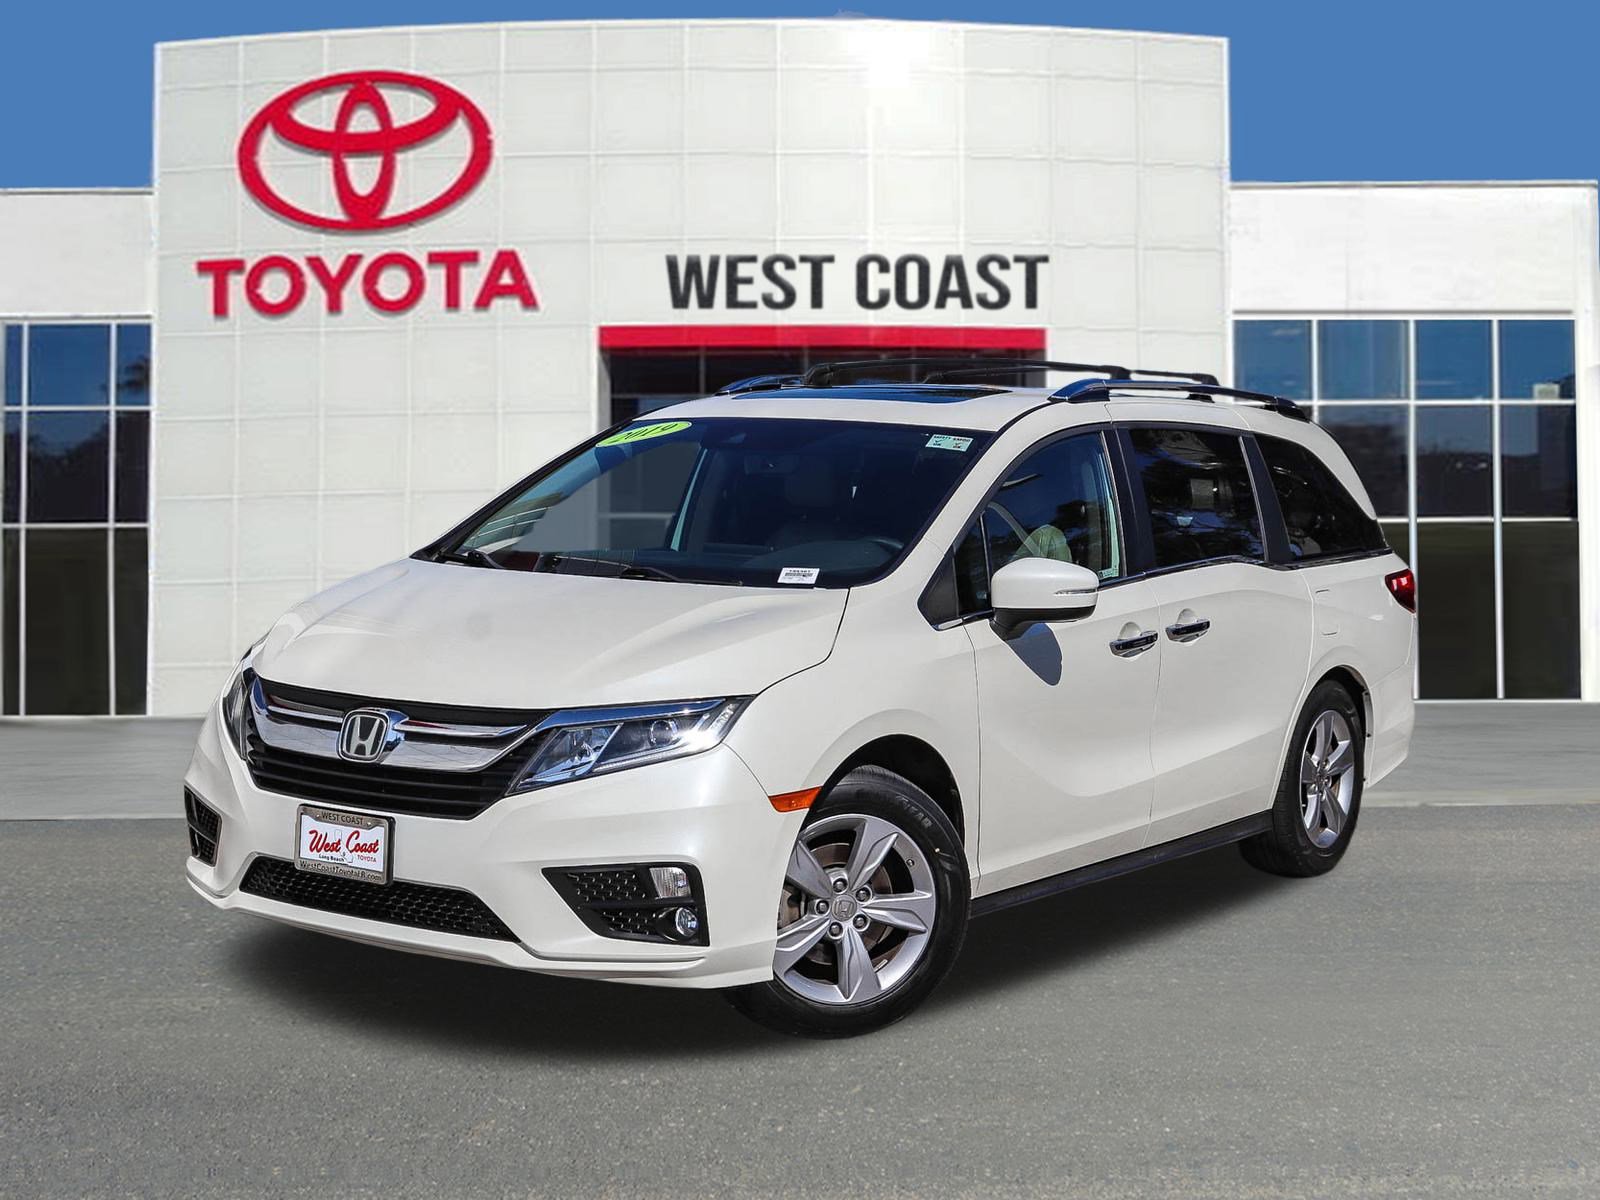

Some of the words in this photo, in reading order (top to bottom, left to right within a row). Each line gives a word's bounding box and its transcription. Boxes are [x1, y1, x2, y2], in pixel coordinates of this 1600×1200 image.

[197, 249, 538, 315] TOYOTA
[666, 255, 835, 310] WEST
[856, 255, 1049, 310] COAST
[321, 811, 340, 822] WEST
[340, 815, 364, 825] COAST
[308, 829, 342, 853] West
[346, 830, 379, 853] Coast
[357, 854, 377, 863] TOYOTA
